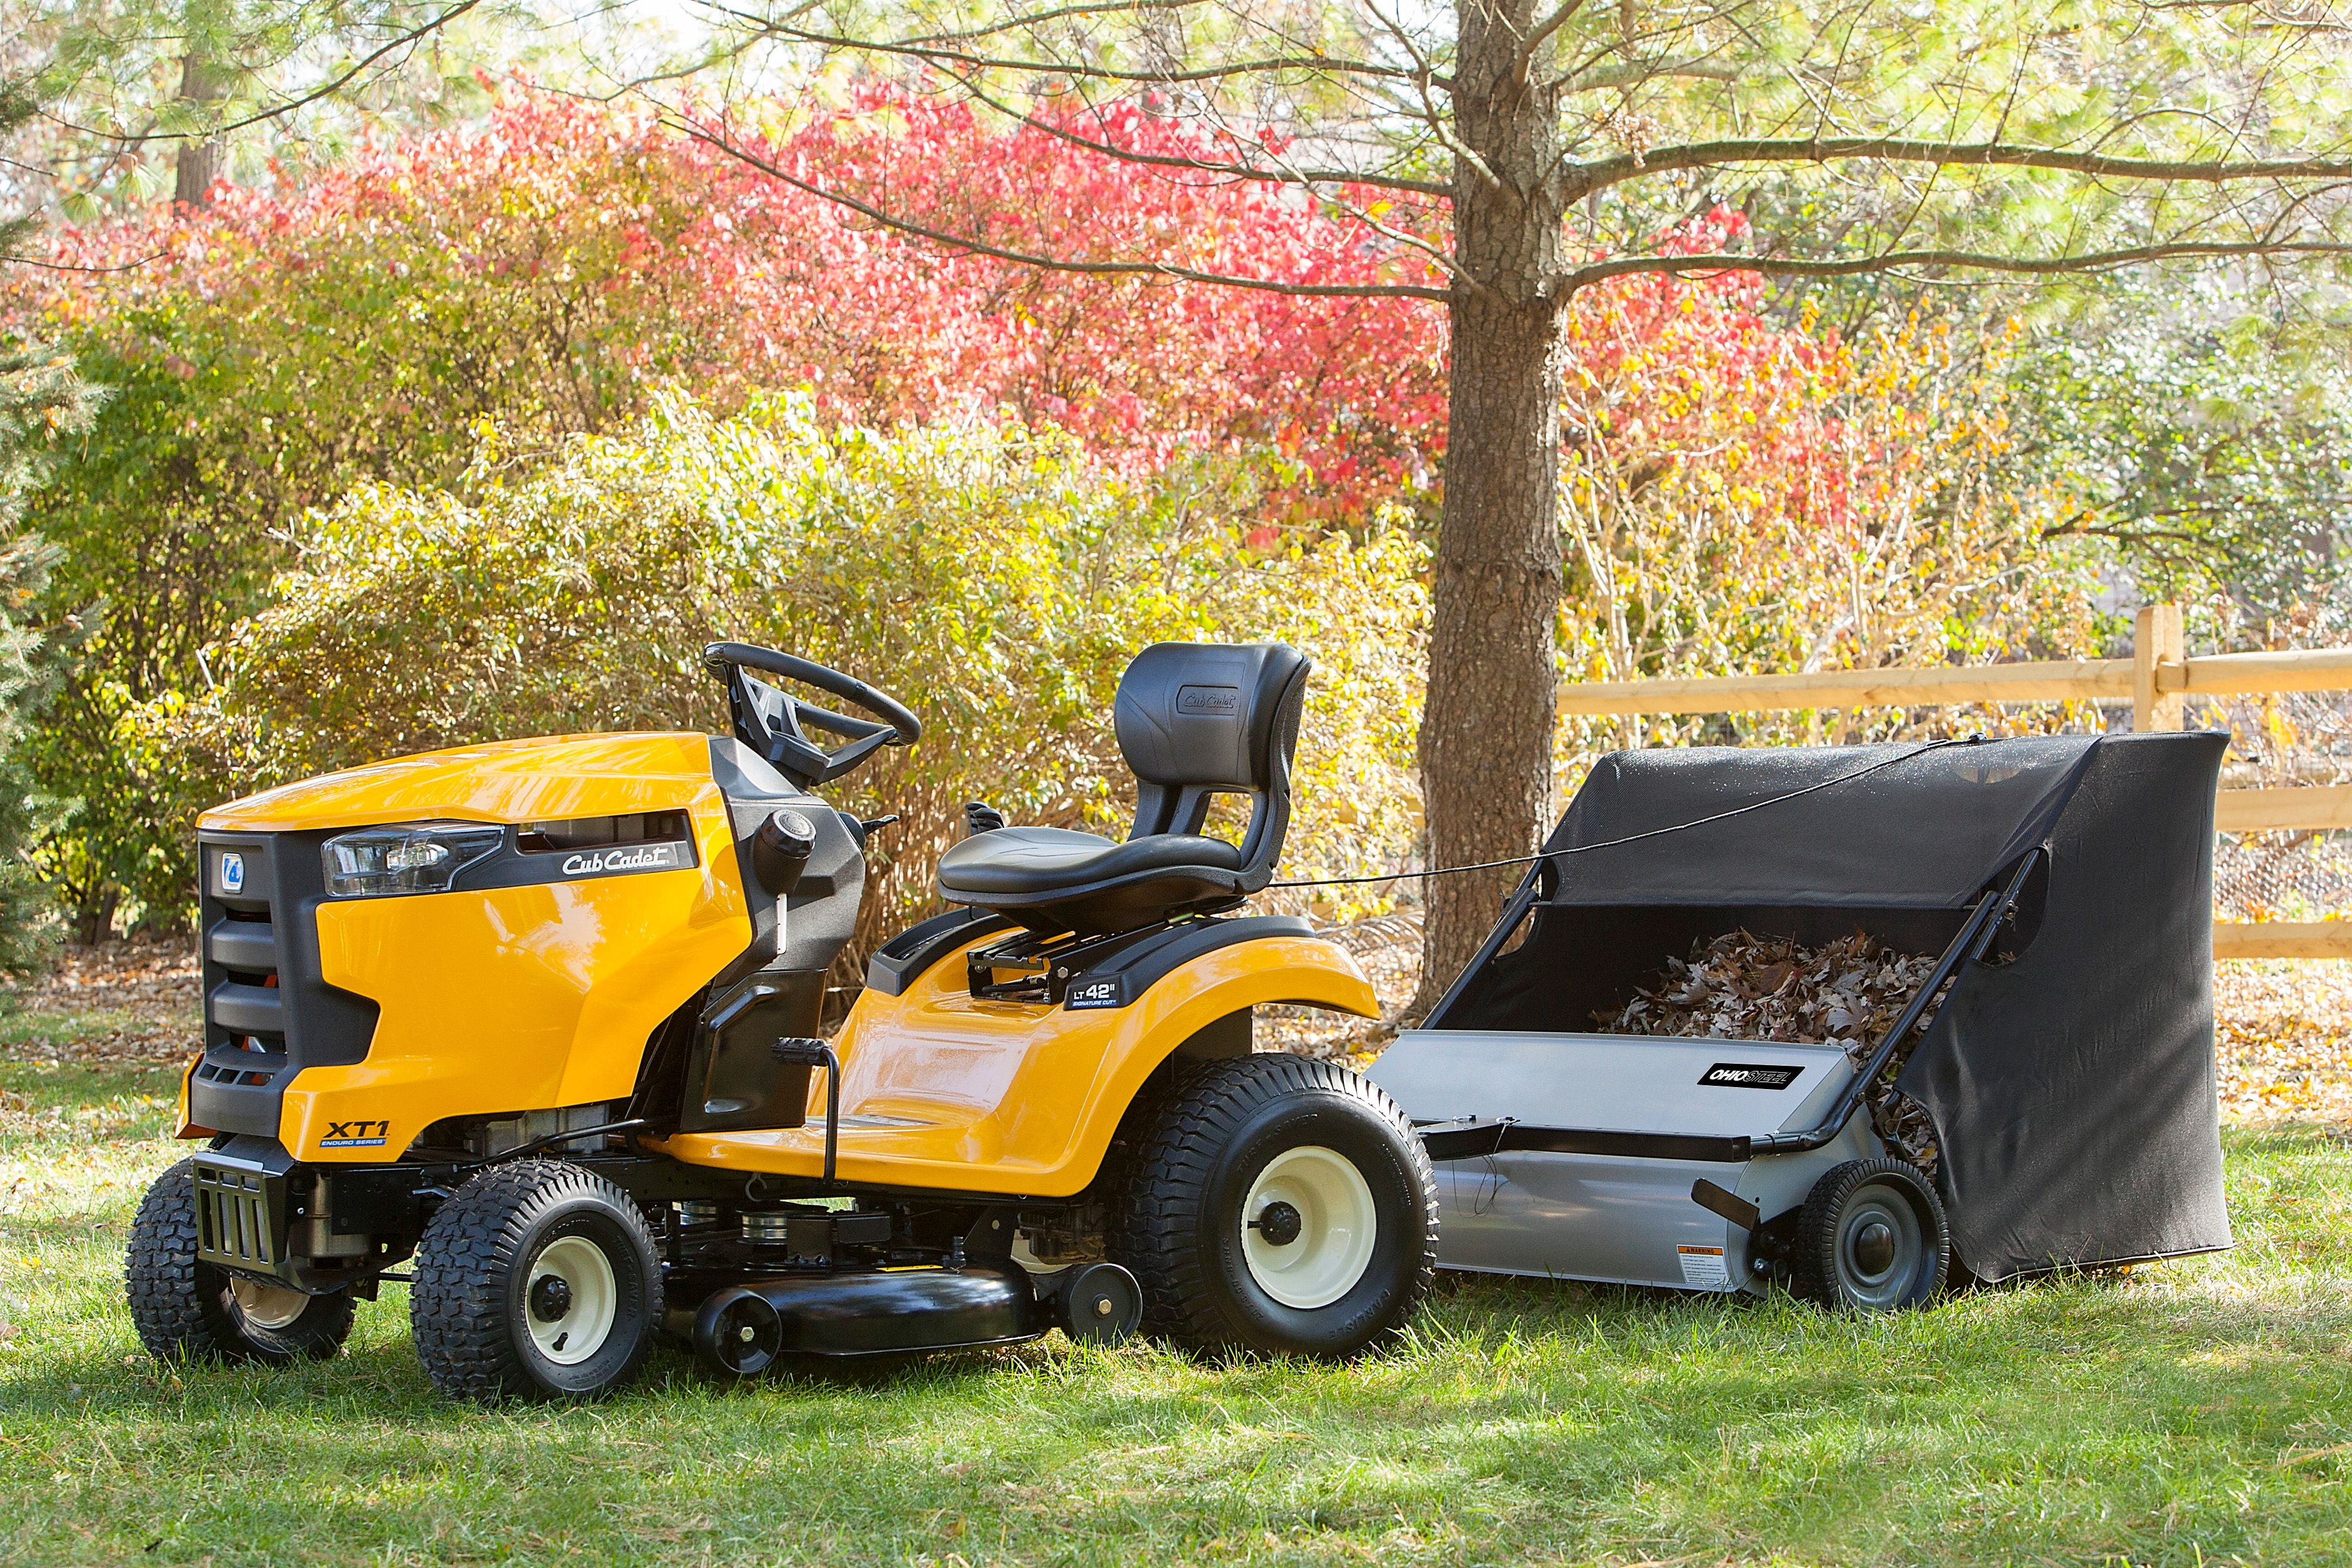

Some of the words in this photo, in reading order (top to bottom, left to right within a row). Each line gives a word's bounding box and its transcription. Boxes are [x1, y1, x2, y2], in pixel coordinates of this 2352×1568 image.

[563, 853, 604, 875] Cub
[604, 847, 668, 870] Cadet
[1073, 991, 1085, 1000] LT
[1086, 983, 1115, 999] 42"
[323, 1120, 390, 1138] XT1
